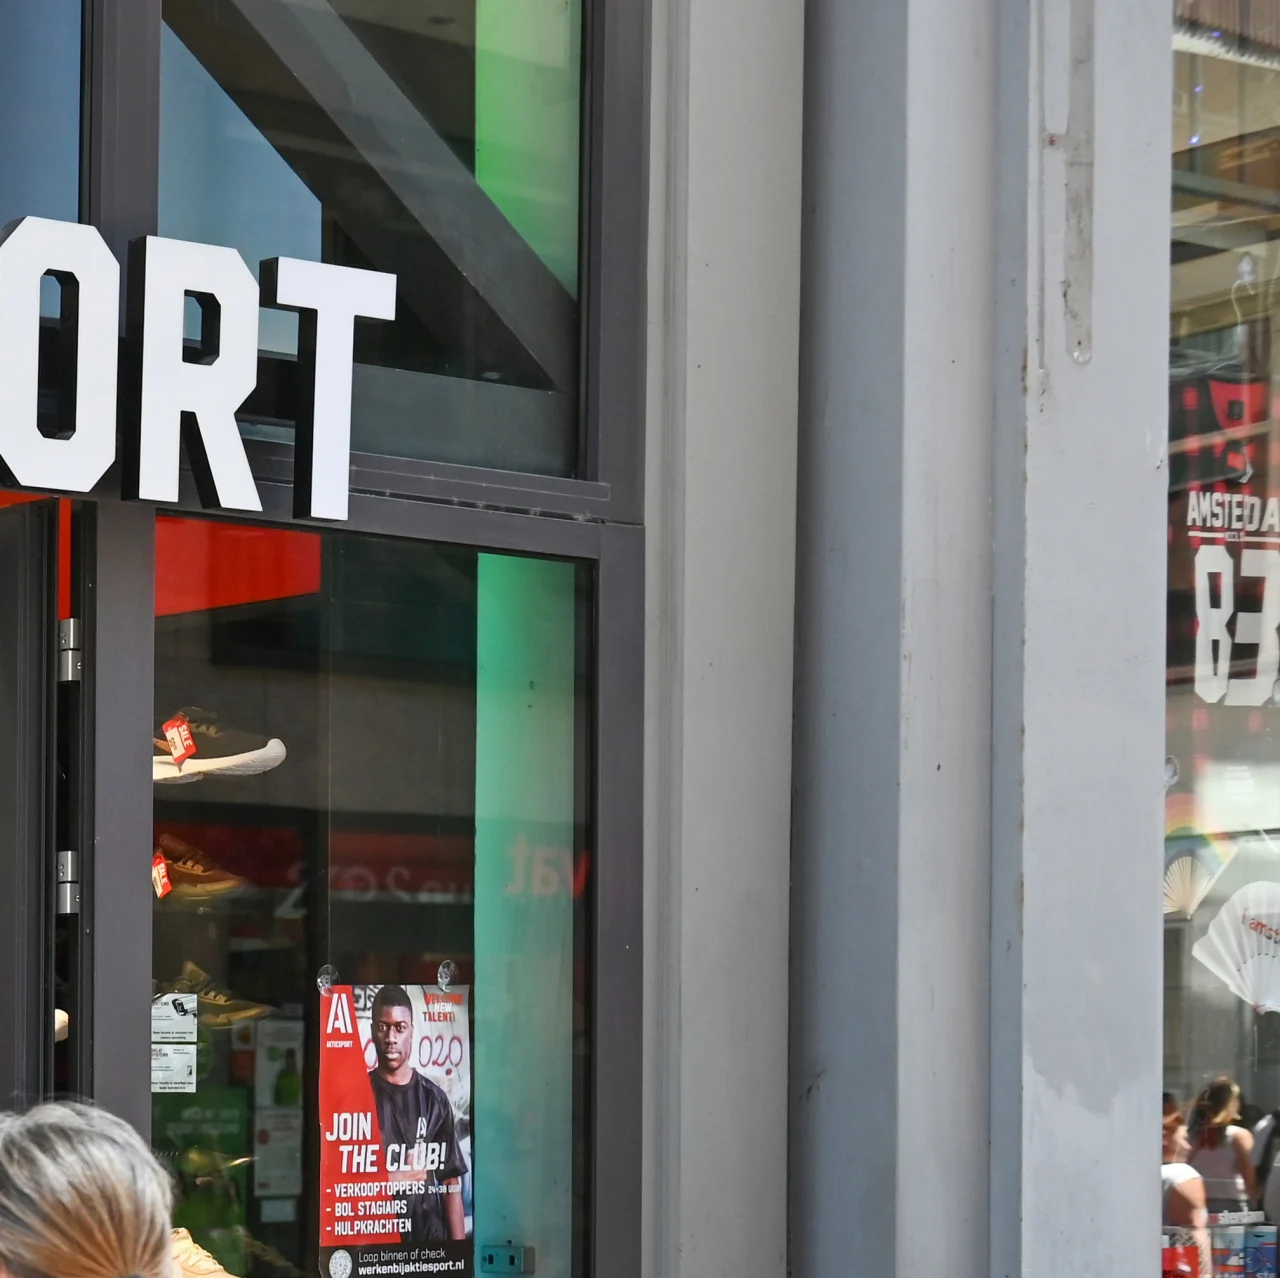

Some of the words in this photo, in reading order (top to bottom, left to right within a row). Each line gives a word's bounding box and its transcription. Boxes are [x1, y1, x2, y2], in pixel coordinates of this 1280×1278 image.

[178, 724, 193, 748] SALE
[422, 1011, 456, 1022] TALENT!
[325, 1112, 372, 1141] JOIN
[339, 1144, 380, 1174] THE
[385, 1142, 447, 1172] CLUB!
[334, 1181, 425, 1198] VERKOOPTOPPERS
[335, 1202, 355, 1217] BOL
[357, 1200, 407, 1216] STAGIAIRS
[334, 1218, 412, 1236] HULPKRACHTEN
[358, 1251, 379, 1263] Loop
[380, 1250, 408, 1262] binnen
[410, 1248, 420, 1260] of
[421, 1248, 446, 1259] check
[358, 1259, 465, 1276] werkenbijaktiesport.nl
